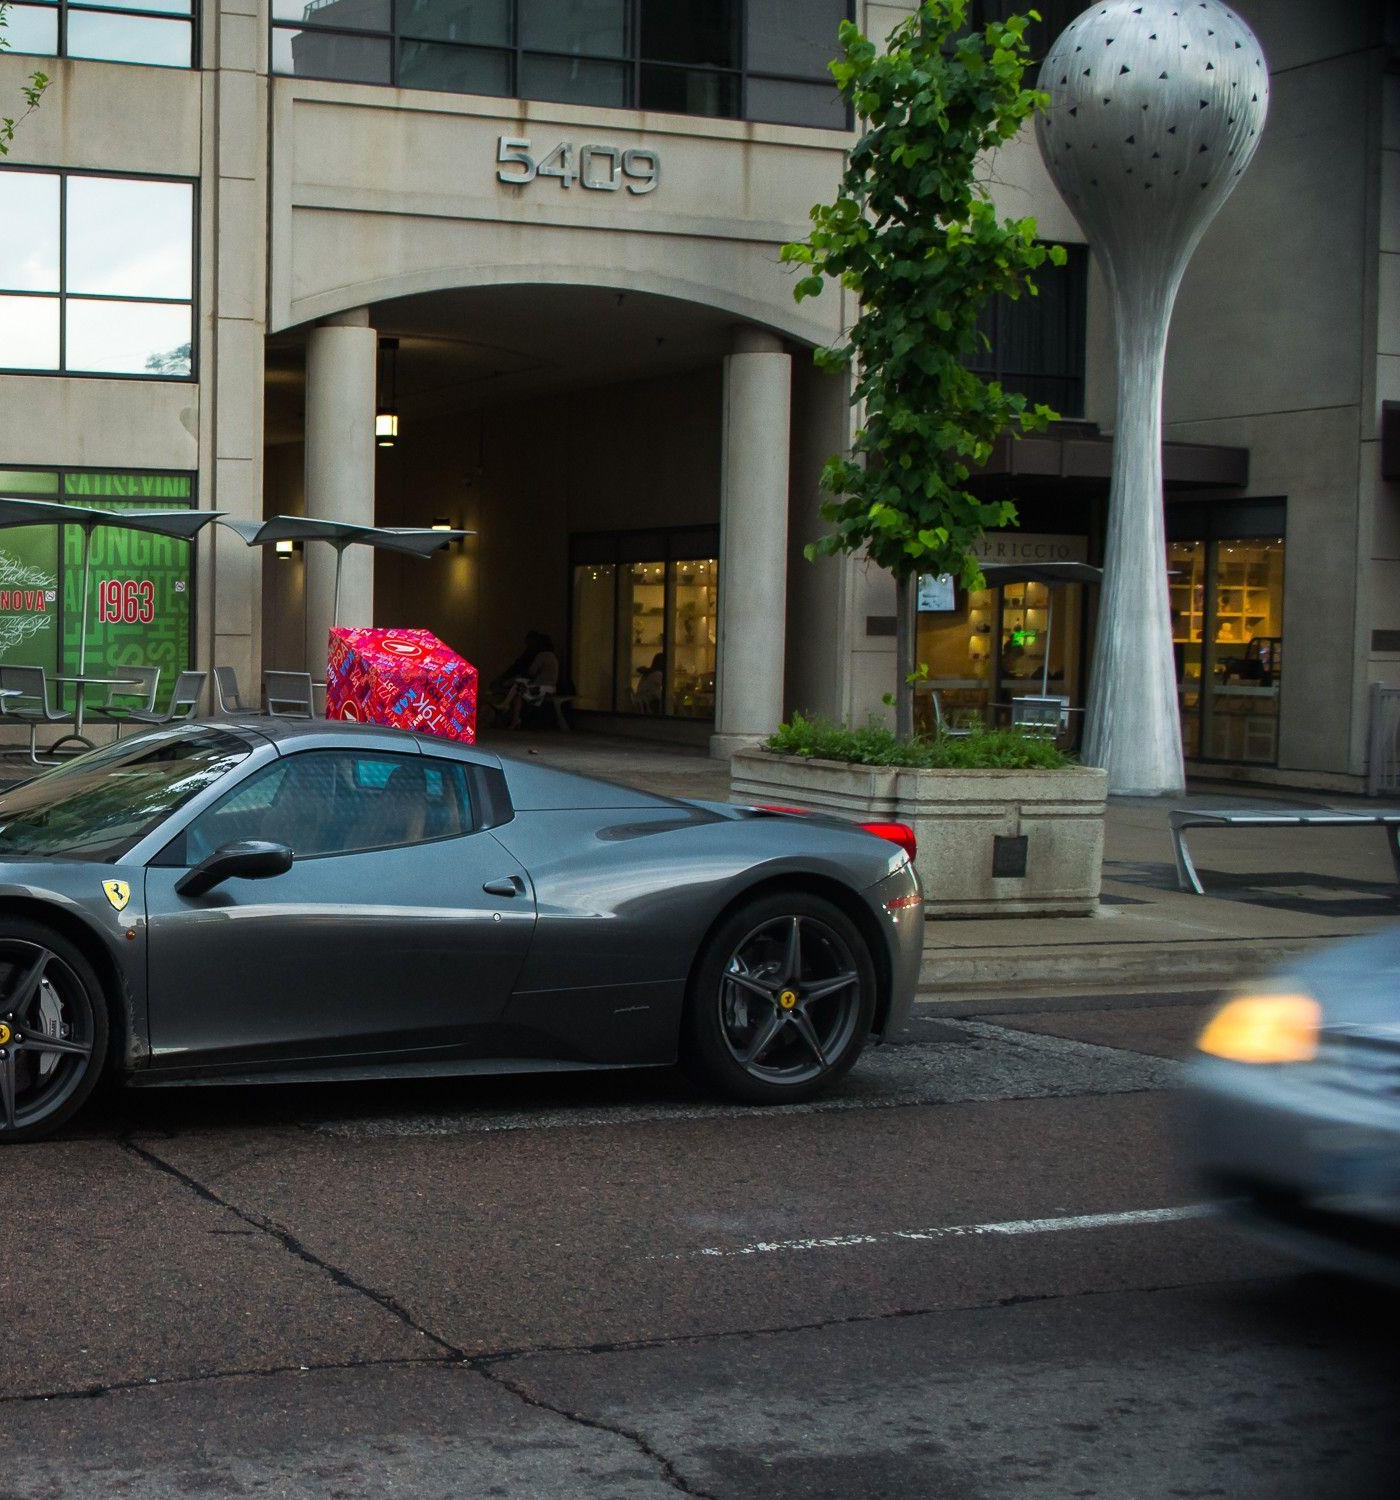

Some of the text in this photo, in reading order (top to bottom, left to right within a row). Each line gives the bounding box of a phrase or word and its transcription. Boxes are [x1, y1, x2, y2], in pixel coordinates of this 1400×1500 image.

[496, 136, 661, 195] 5409
[969, 542, 1070, 559] APRICCIO
[0, 590, 46, 612] NOVA
[99, 580, 155, 624] 1963
[412, 692, 442, 731] T9K
